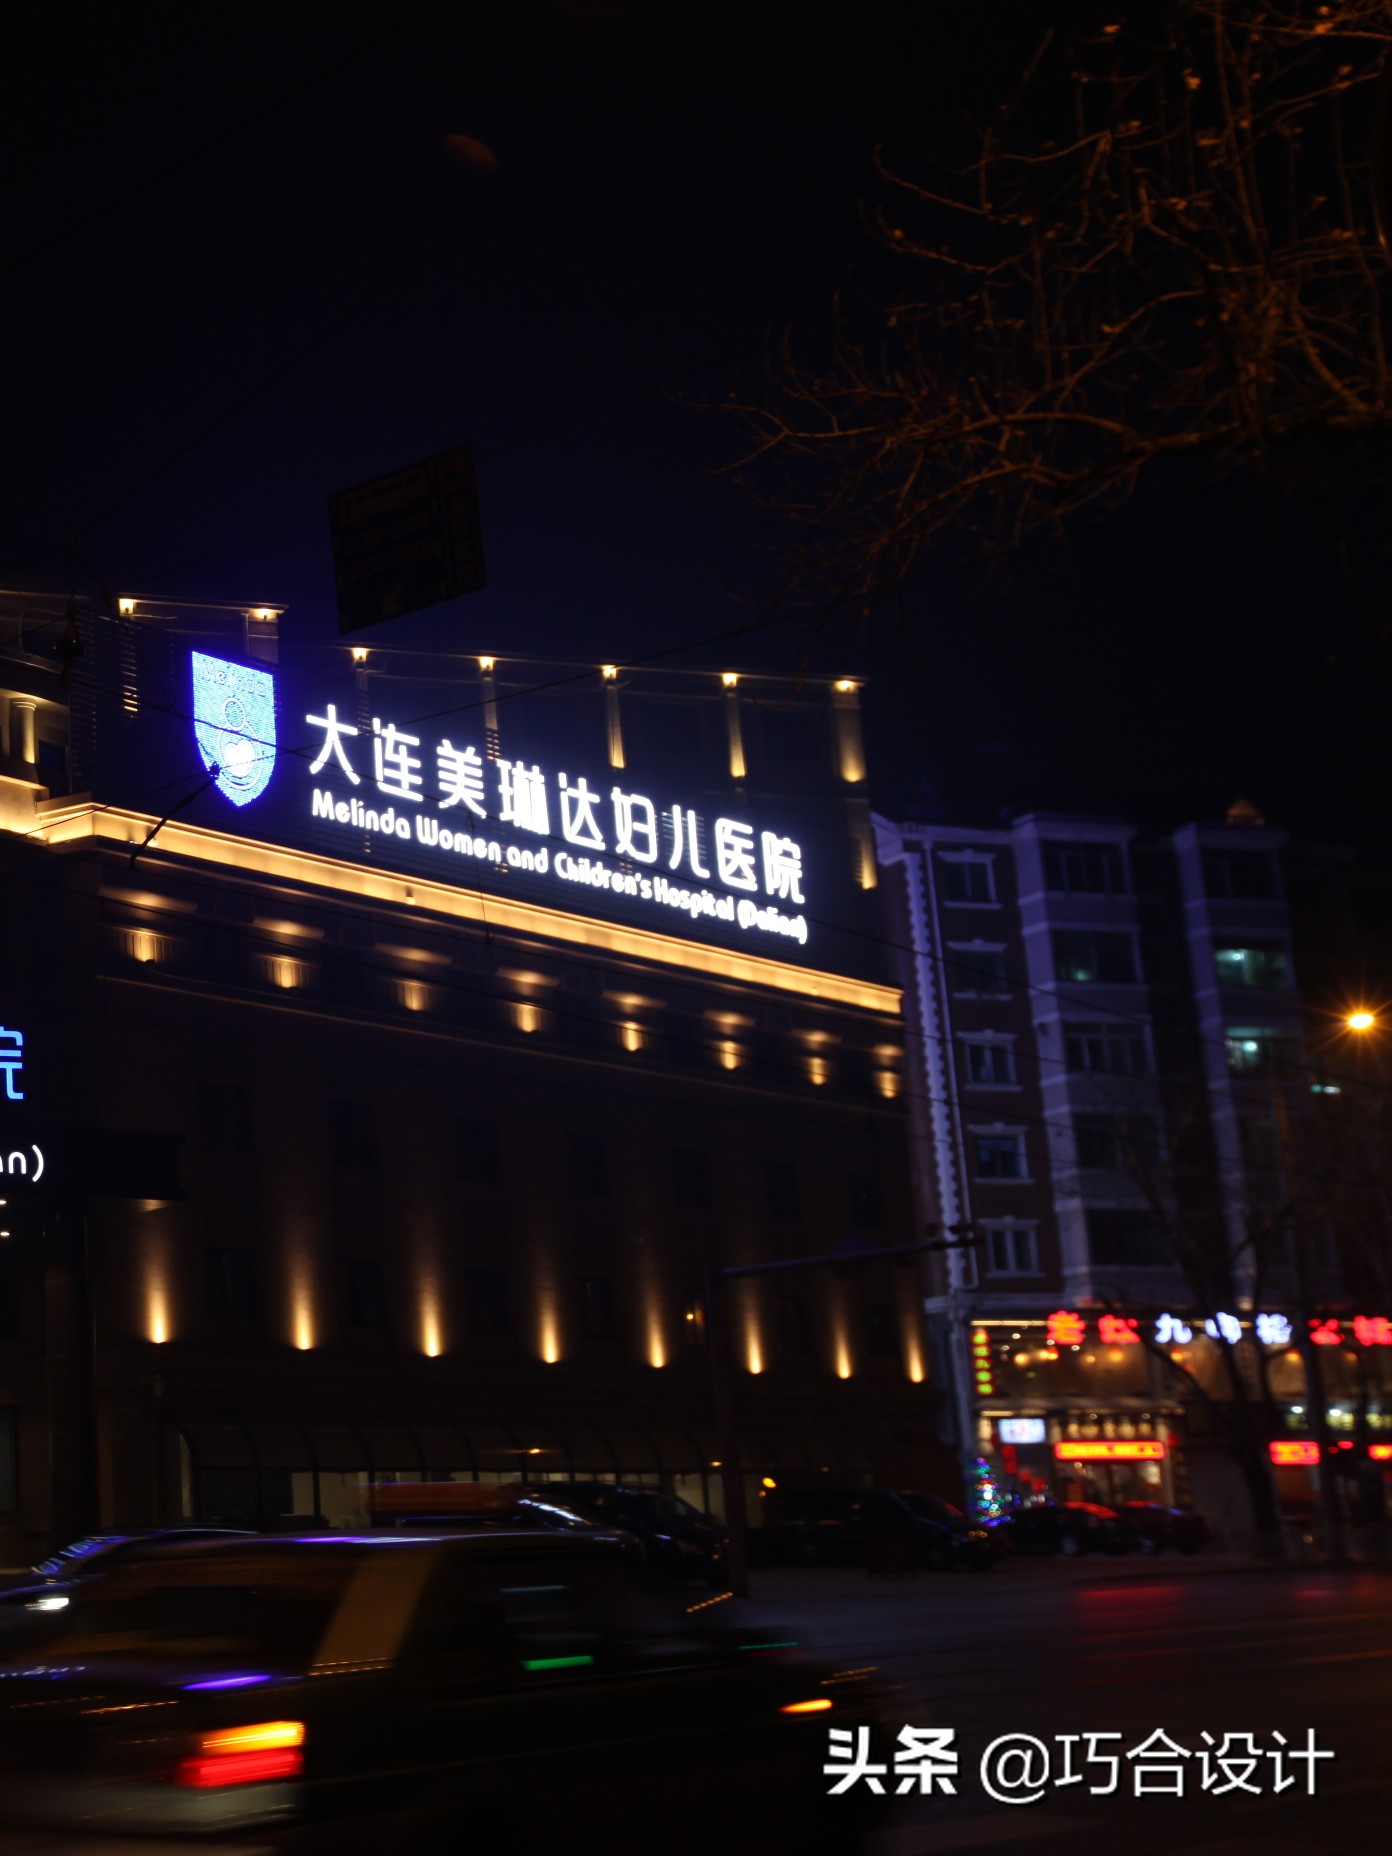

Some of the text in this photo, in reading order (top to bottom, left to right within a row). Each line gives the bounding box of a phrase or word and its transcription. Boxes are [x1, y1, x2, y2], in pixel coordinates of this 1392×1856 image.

[306, 704, 805, 903] 大连美琳达妇儿医院
[313, 789, 807, 944] Melinda Women and Children's Hospital (Dalian)
